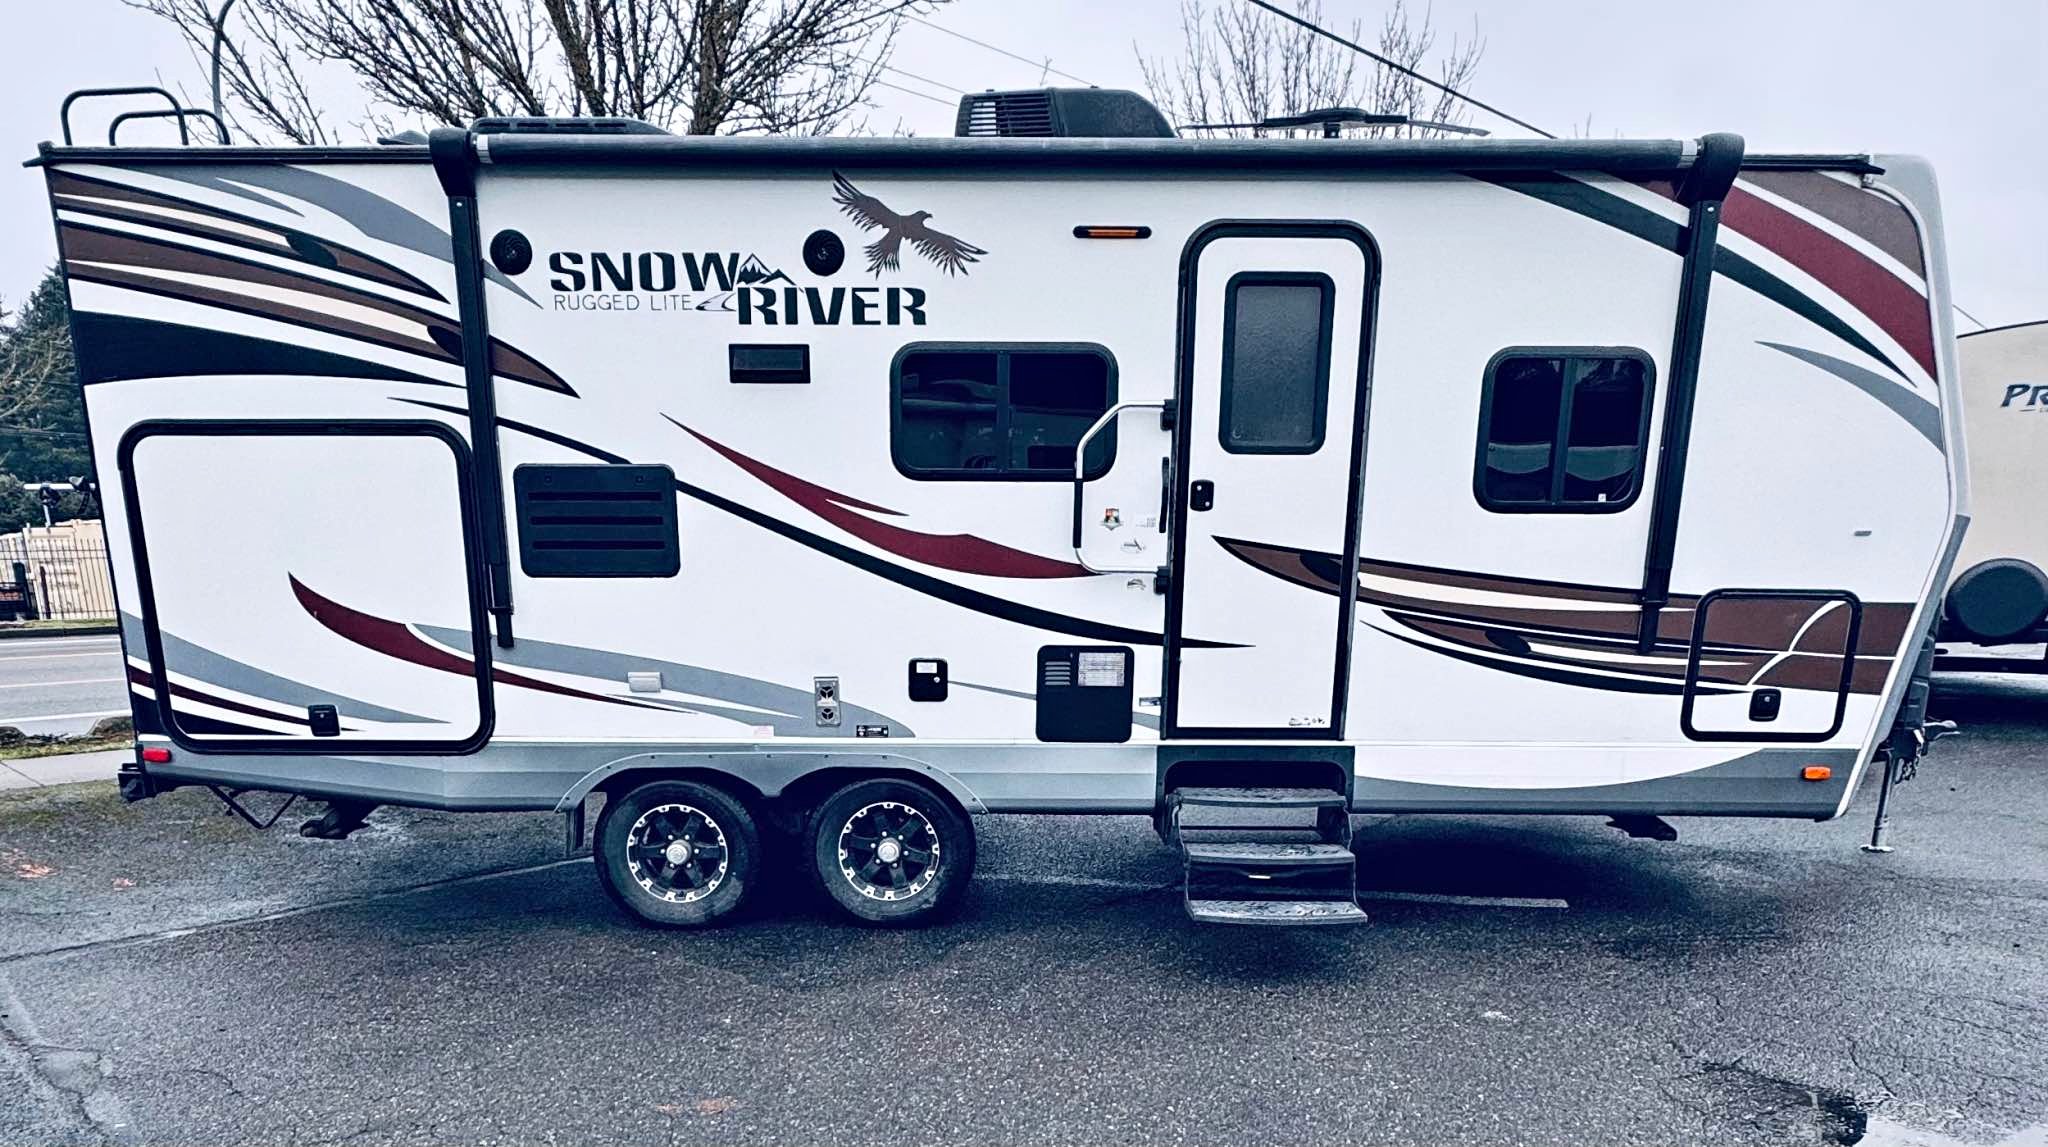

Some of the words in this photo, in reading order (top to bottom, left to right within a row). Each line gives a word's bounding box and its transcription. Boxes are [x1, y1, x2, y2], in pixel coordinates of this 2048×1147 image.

[549, 252, 740, 292] SNOW
[554, 294, 640, 311] RUGGED
[650, 294, 693, 311] LITE
[737, 287, 927, 325] RIVER
